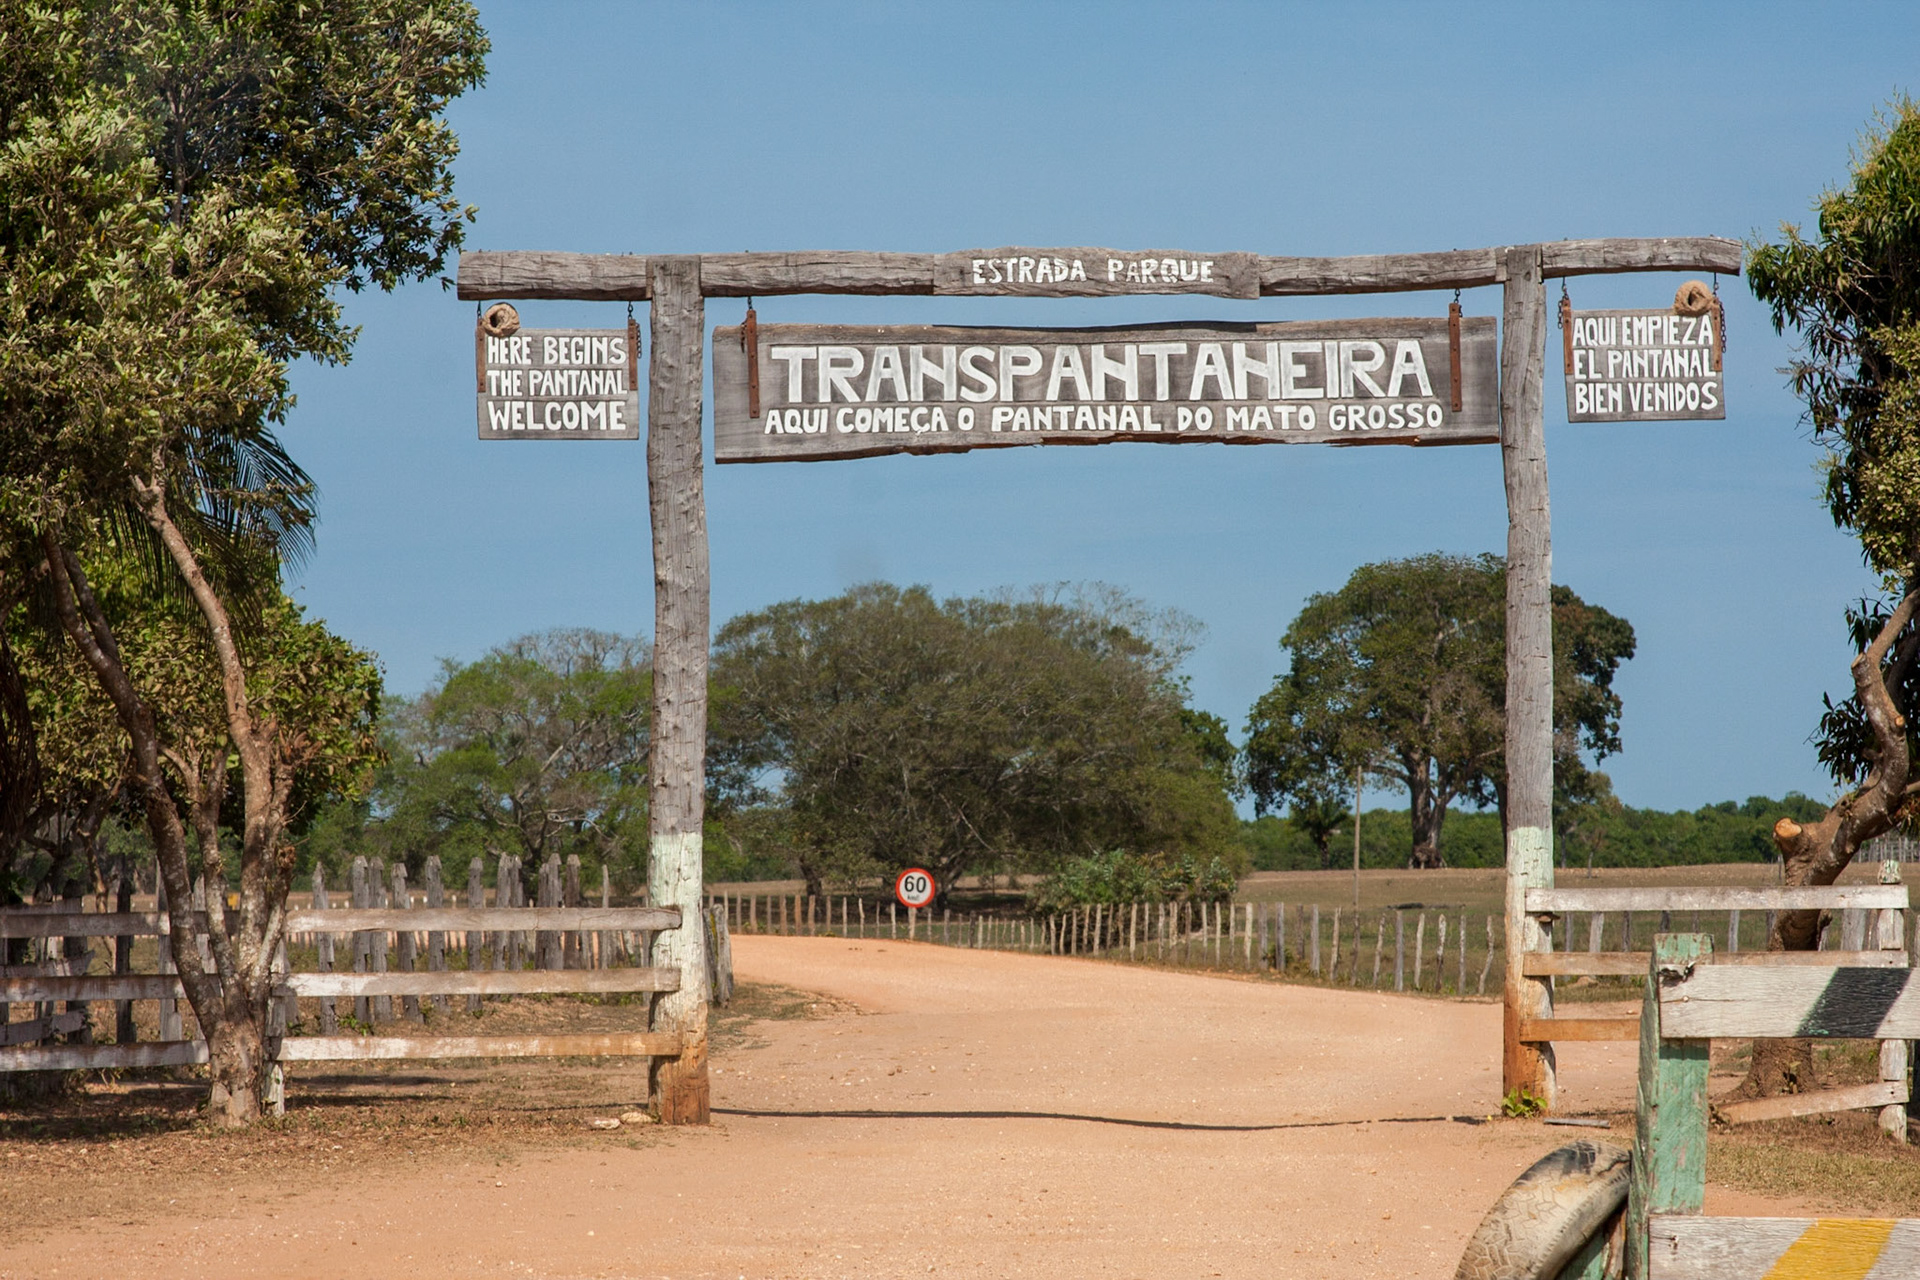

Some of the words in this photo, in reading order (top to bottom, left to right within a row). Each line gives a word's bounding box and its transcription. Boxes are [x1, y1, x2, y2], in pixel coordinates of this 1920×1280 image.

[972, 256, 1087, 284] ESTRADA
[1107, 258, 1215, 283] PARQUE
[1572, 317, 1617, 347] AQUI
[1621, 314, 1714, 346] EMPIEZA
[487, 336, 532, 365] HERE
[543, 336, 627, 365] BEGINS
[1573, 348, 1602, 380] EL
[1607, 348, 1717, 379] PANTANAL
[486, 369, 523, 397] THE
[528, 369, 628, 397] PANTANAL
[771, 339, 1434, 403] TRANSPANTANEIRA
[1575, 382, 1623, 414] BIEN
[1628, 381, 1719, 412] VENIDOS
[487, 400, 627, 431] WELCOME
[764, 408, 829, 434] AQUI
[835, 406, 949, 436] COMEÇA
[957, 407, 975, 431] O
[991, 404, 1162, 432] PANTANAL
[1177, 405, 1213, 431] DO
[1226, 405, 1316, 431] MATO
[1328, 403, 1444, 431] GROSSO
[904, 875, 927, 894] 60
